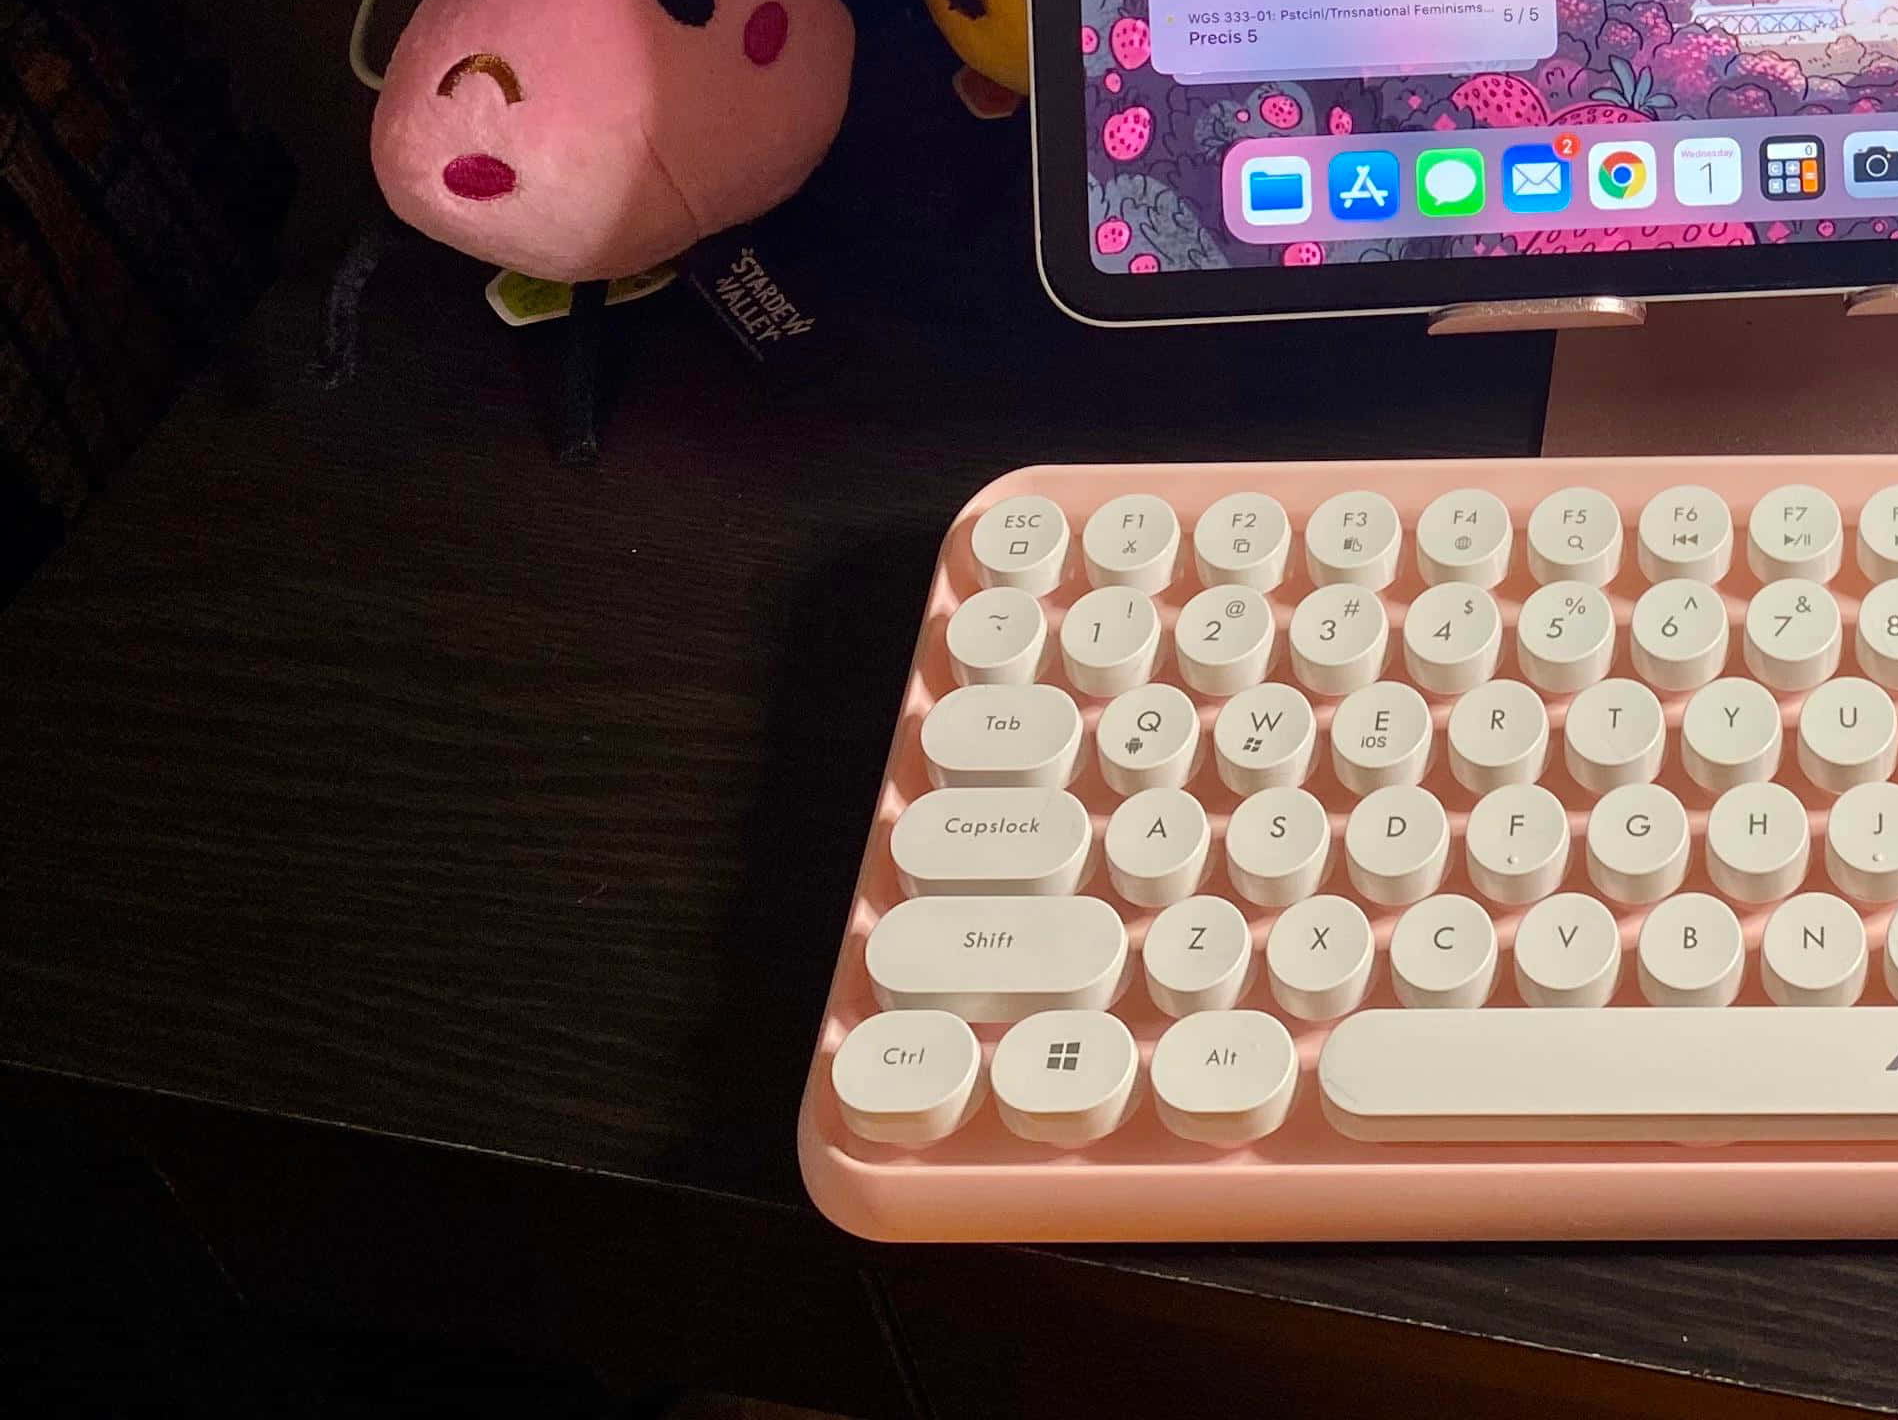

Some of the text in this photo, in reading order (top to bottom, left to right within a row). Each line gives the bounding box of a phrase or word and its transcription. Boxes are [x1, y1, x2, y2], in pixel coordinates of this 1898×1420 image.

[1188, 13, 1220, 24] WGS
[1504, 9, 1513, 22] 5
[1530, 7, 1538, 21] 5
[1189, 29, 1257, 45] Precis 5
[1563, 139, 1572, 154] 2
[731, 254, 815, 336] STARDEW
[716, 277, 781, 341] VALLEY
[1004, 514, 1042, 529] ESC
[1122, 513, 1145, 529] F1
[1231, 512, 1257, 529] F2
[1343, 511, 1368, 528] F3
[1453, 510, 1478, 525] F4
[1562, 508, 1587, 525] F5
[1673, 506, 1699, 523] F6
[1783, 506, 1809, 522] F7
[986, 715, 1021, 731] Tab
[1136, 710, 1162, 733] Q
[1250, 711, 1284, 733] W
[1374, 710, 1391, 732] E
[1490, 709, 1506, 731] R
[1608, 707, 1623, 729] T
[1723, 707, 1740, 728] Y
[1839, 706, 1858, 729] U
[1360, 735, 1388, 749] iOS
[944, 817, 1041, 837] Capslock
[1145, 816, 1167, 839] A
[1269, 815, 1287, 839] S
[1386, 815, 1407, 838] D
[1509, 814, 1525, 837] F
[1625, 814, 1651, 838] G
[1748, 813, 1768, 836] H
[963, 931, 1014, 949] Shift
[882, 1047, 925, 1065] Ctrl
[1205, 1048, 1237, 1066] Alt
